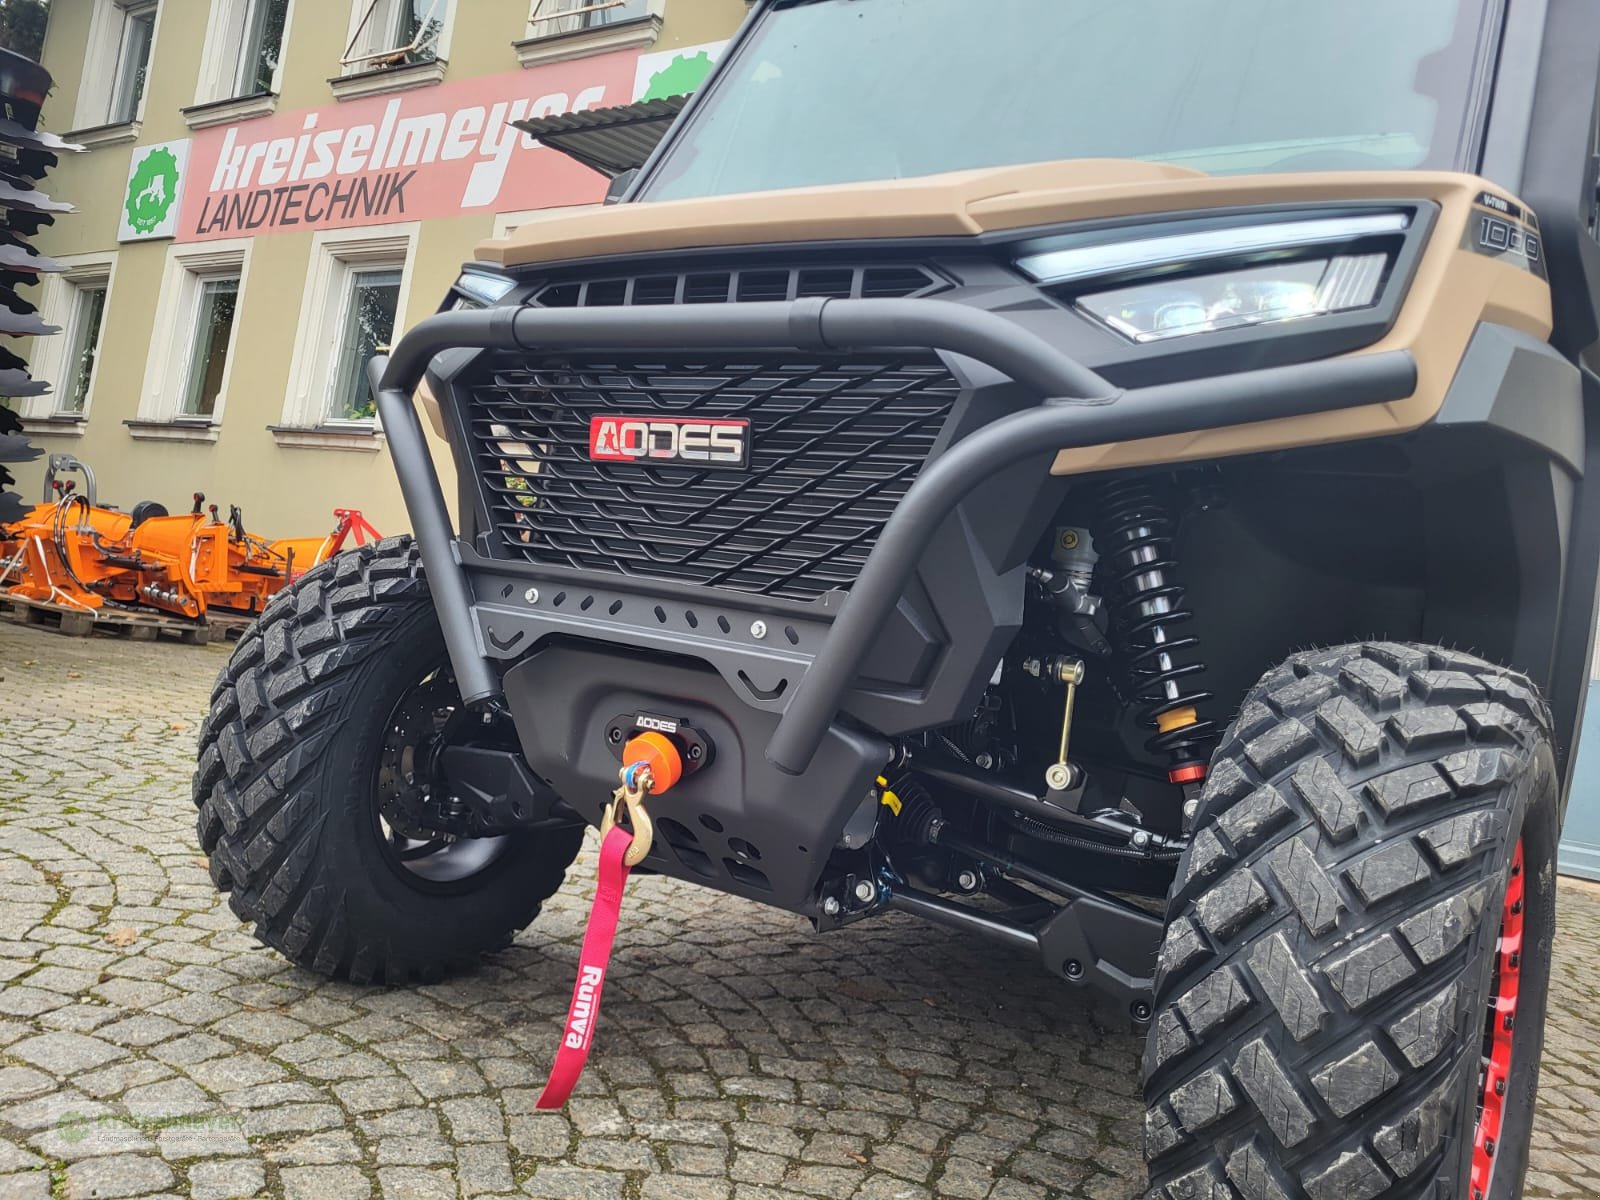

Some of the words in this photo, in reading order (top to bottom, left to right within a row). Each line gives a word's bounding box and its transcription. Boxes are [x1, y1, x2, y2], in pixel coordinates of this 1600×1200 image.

[196, 170, 417, 234] LANDTECHNIK
[594, 421, 744, 462] AODES
[636, 716, 677, 733] AODES
[565, 965, 602, 1049] Runva
